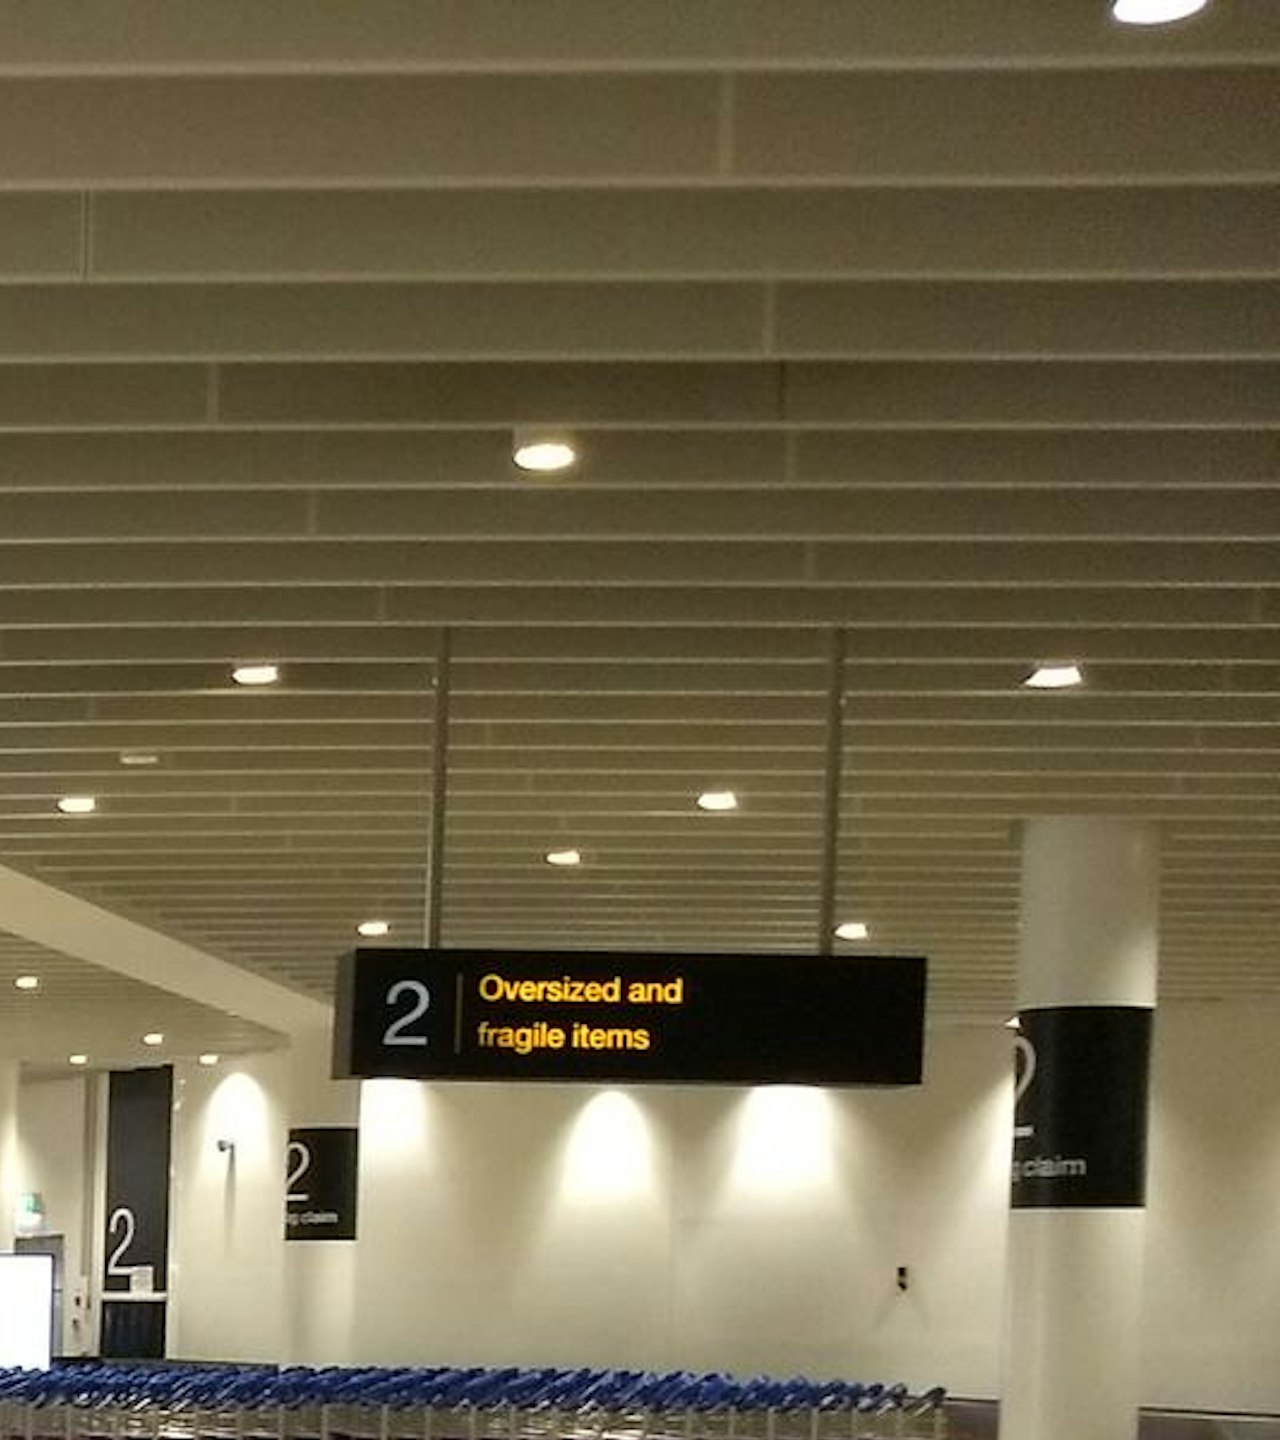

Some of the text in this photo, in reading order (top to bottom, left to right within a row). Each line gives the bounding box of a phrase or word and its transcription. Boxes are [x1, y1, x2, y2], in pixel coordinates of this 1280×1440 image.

[478, 976, 684, 1003] Oversized and
[383, 980, 430, 1046] 2
[478, 1022, 650, 1054] fragile items
[1023, 1155, 1087, 1177] claim
[107, 1208, 138, 1276] 2
